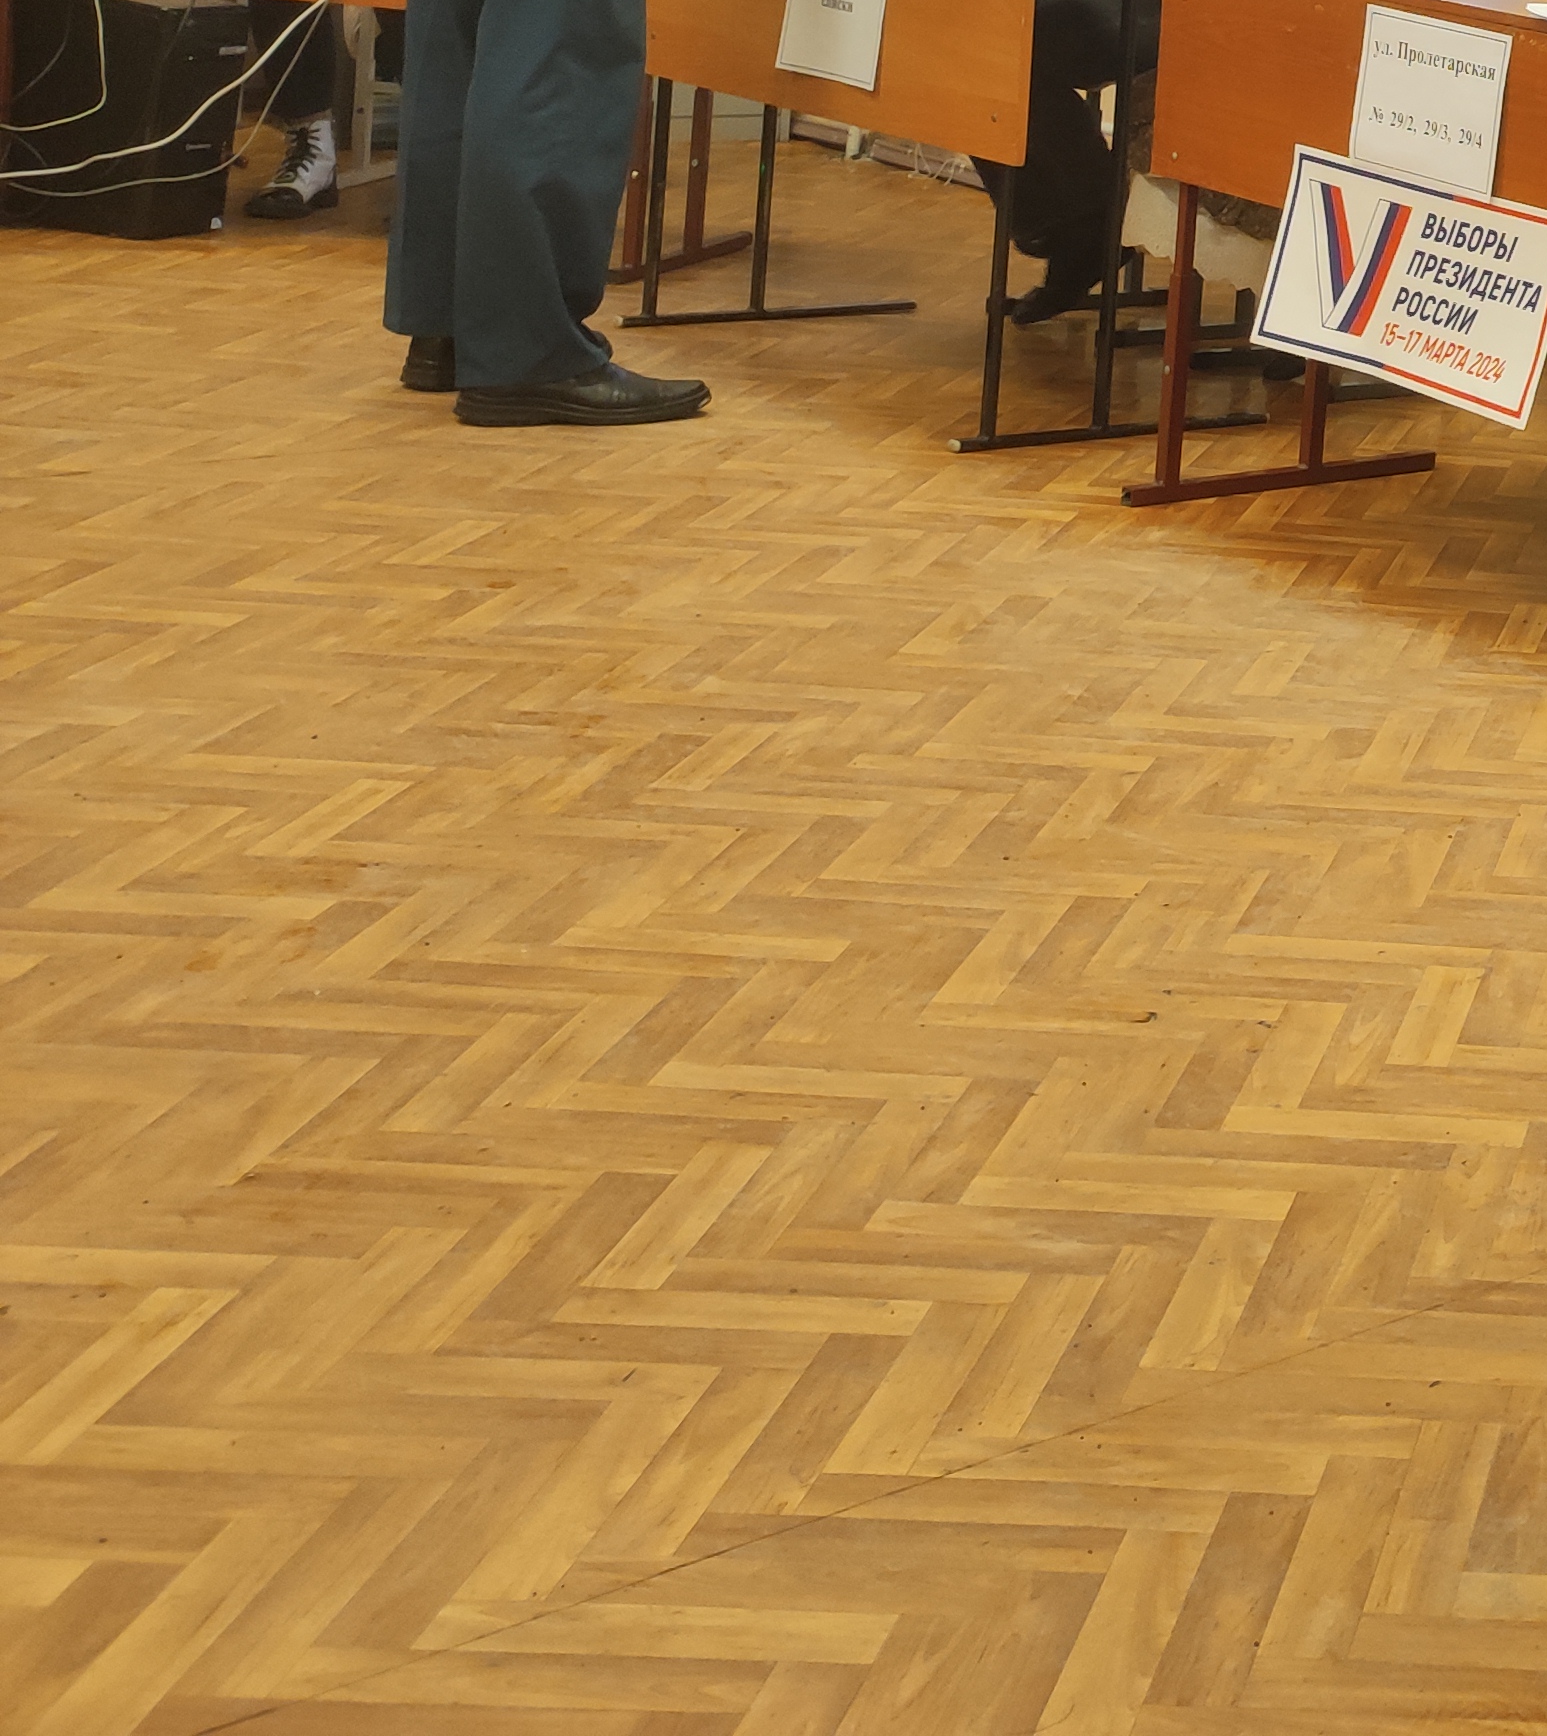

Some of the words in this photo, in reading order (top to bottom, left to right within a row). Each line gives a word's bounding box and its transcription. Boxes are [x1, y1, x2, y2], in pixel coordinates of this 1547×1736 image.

[1372, 40, 1393, 58] ул.
[1397, 41, 1496, 81] Пролетарская
[1368, 106, 1384, 124] №
[1390, 111, 1417, 136] 29/2,
[1423, 120, 1452, 144] 29/3,
[1458, 128, 1483, 149] 29/4
[1421, 212, 1519, 263] ВЫБОРЫ
[1406, 249, 1543, 313] ПРЕЗИДЕНТА
[1392, 287, 1479, 335] РОССИИ
[1418, 341, 1472, 372] МАРТА
[1466, 353, 1507, 384] 2024
